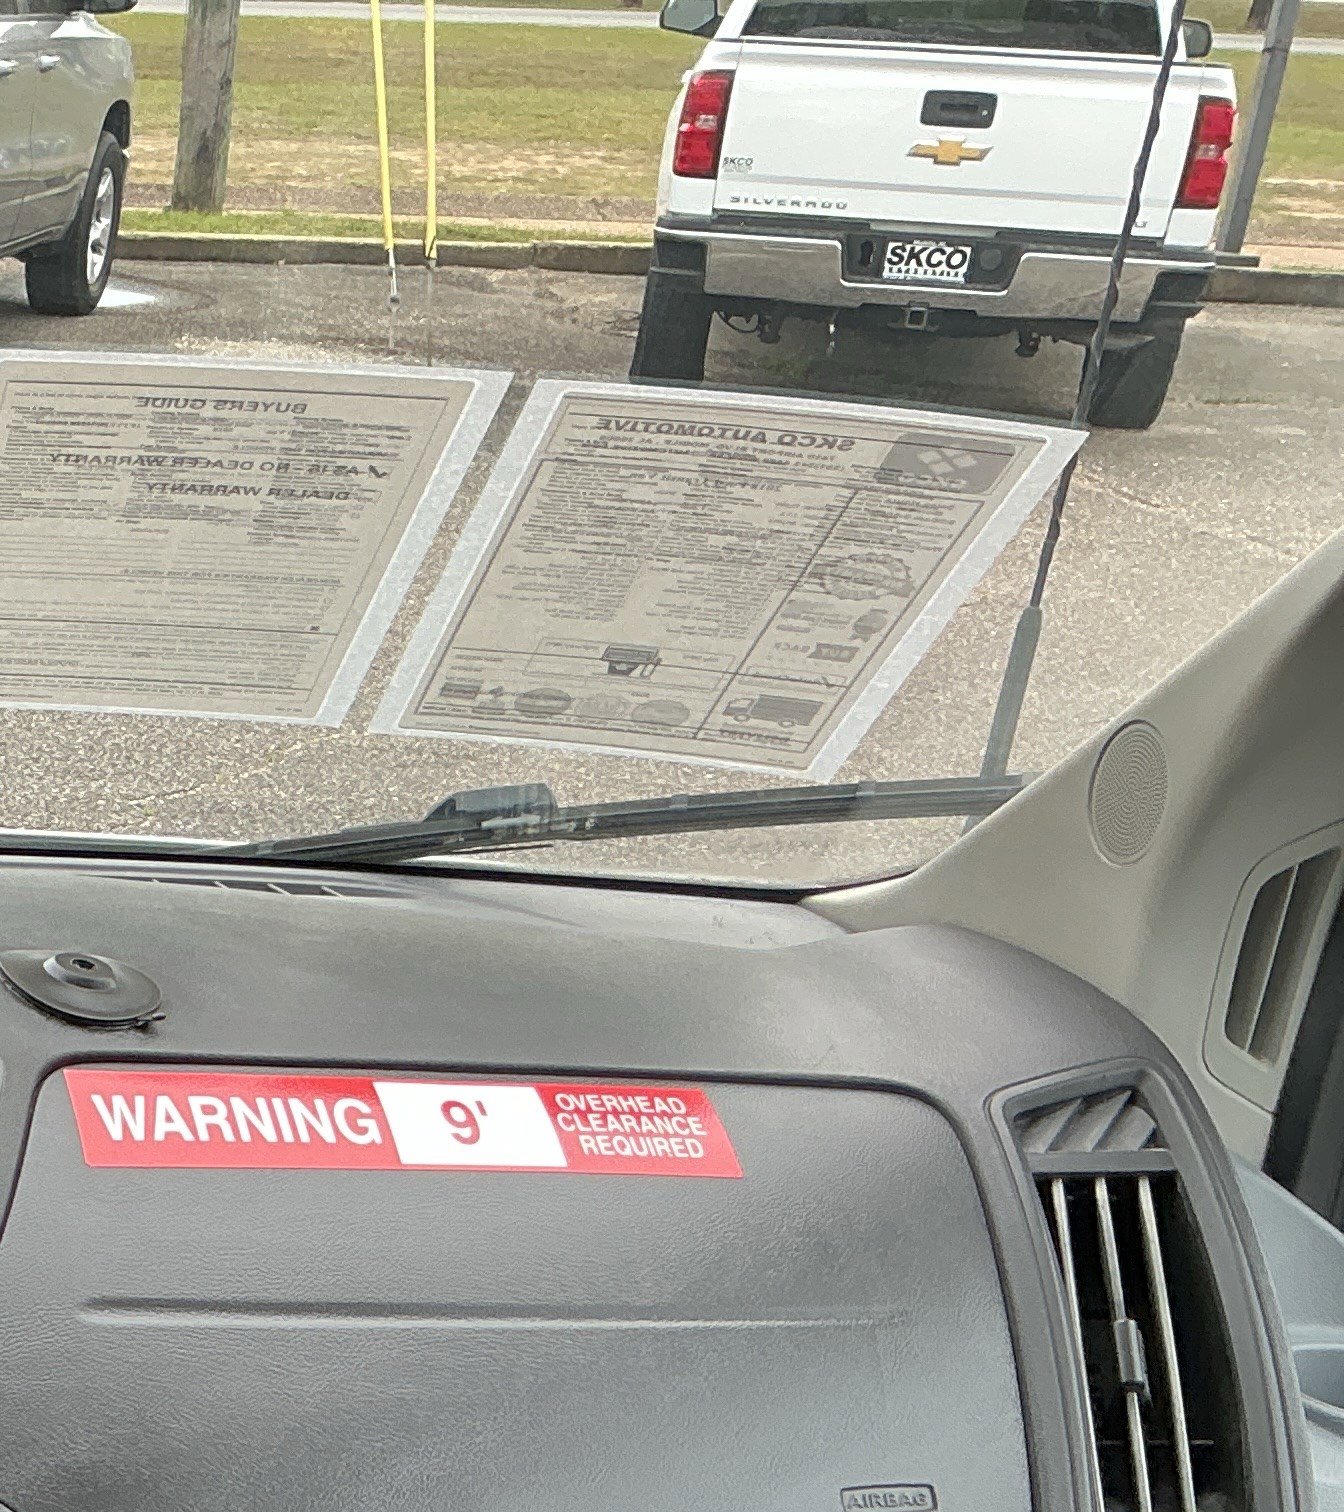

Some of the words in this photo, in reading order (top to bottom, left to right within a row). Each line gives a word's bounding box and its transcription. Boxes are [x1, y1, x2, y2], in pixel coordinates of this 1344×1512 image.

[723, 157, 753, 166] SKCO
[730, 196, 848, 210] SILVERADO
[887, 245, 968, 270] SKCO
[554, 1093, 687, 1116] OVERHEAD
[91, 1095, 382, 1145] WARNING
[439, 1100, 489, 1145] 9'
[556, 1112, 708, 1137] CLEARANCE
[580, 1134, 705, 1158] REQUIRED
[847, 1493, 928, 1509] AIRBAG
